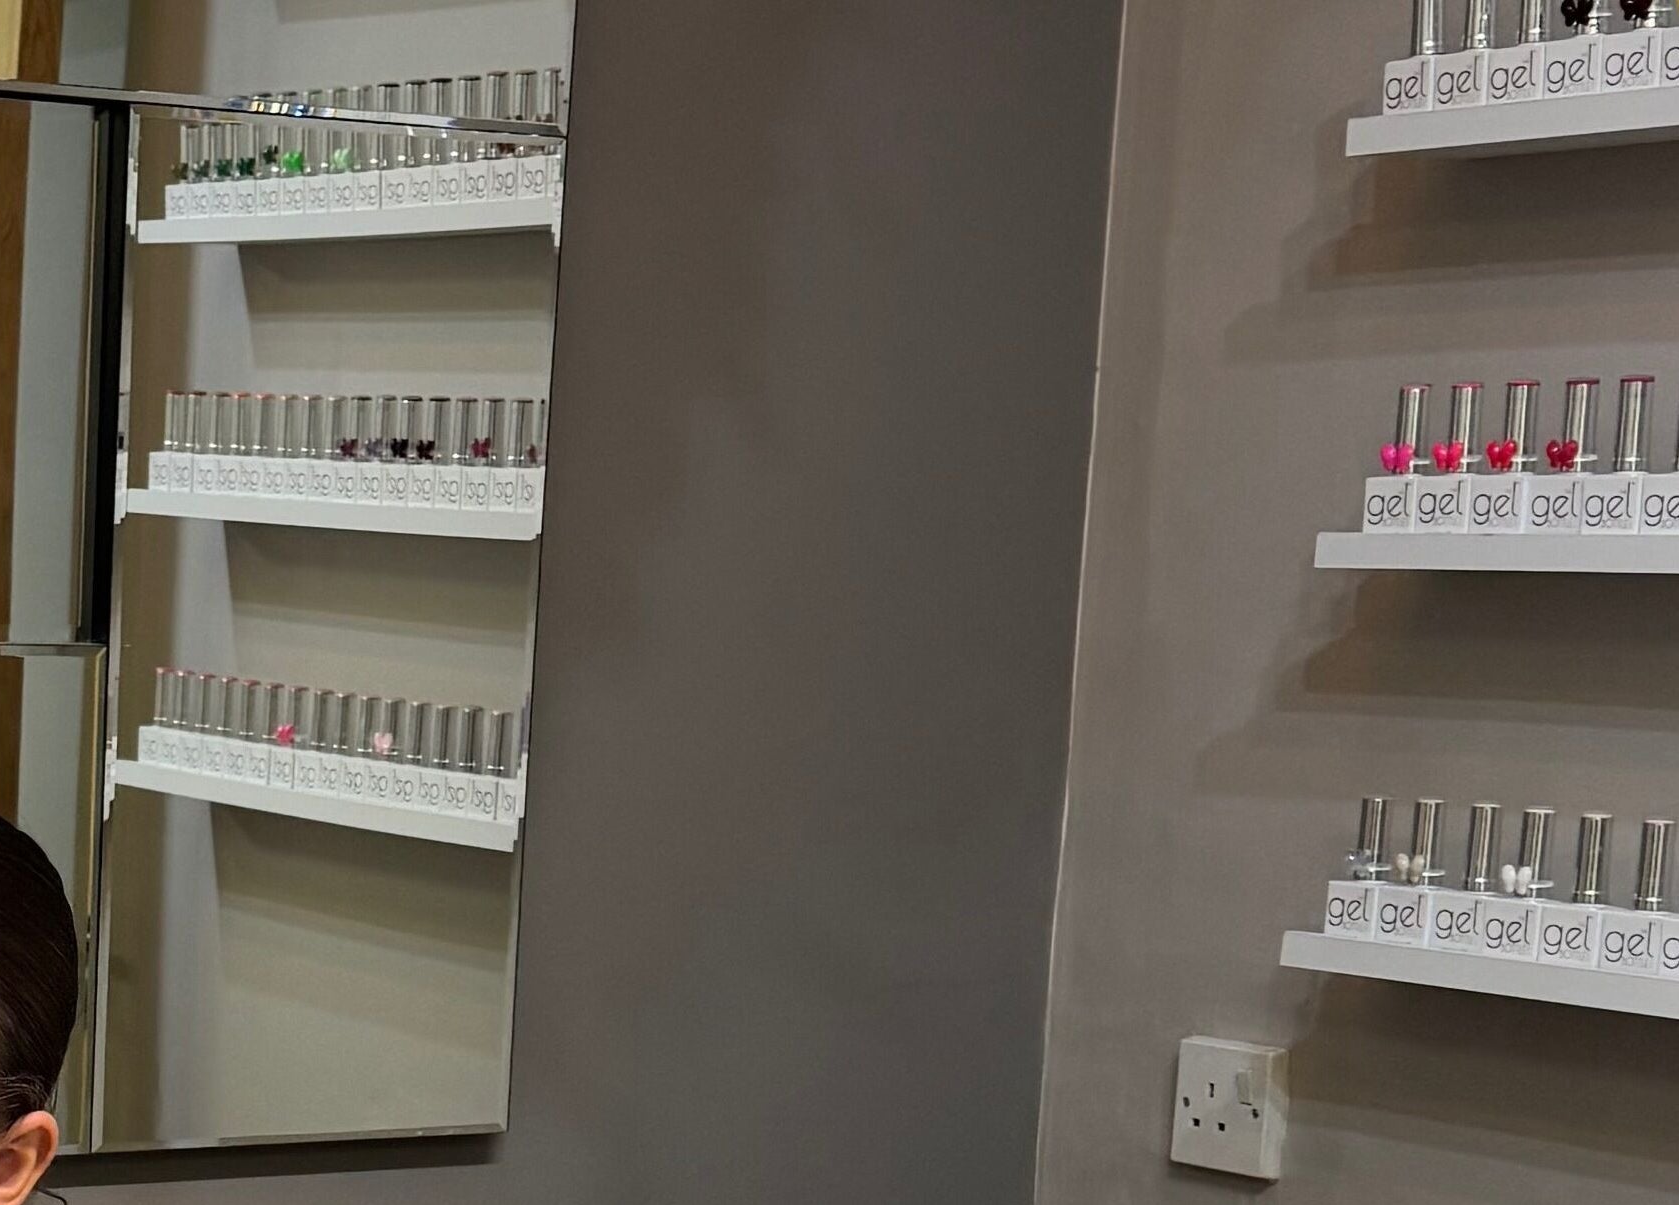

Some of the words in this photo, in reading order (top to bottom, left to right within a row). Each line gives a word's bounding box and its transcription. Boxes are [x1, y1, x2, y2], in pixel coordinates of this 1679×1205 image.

[1436, 55, 1481, 105] gel
[1490, 49, 1536, 99] gel
[1547, 43, 1596, 93] gel
[1605, 36, 1654, 86] gel
[1385, 61, 1427, 110] gel
[1367, 482, 1410, 525] gel
[1418, 480, 1463, 524] gel
[1473, 481, 1520, 525] gel
[1531, 481, 1579, 527] gel
[1585, 481, 1634, 527] gel
[1644, 494, 1679, 527] ge
[1328, 888, 1370, 927] gel
[1380, 894, 1423, 934] gel
[1436, 900, 1480, 940] gel
[1486, 909, 1534, 949] gel
[1544, 916, 1594, 956] gel
[1605, 922, 1657, 962] gel
